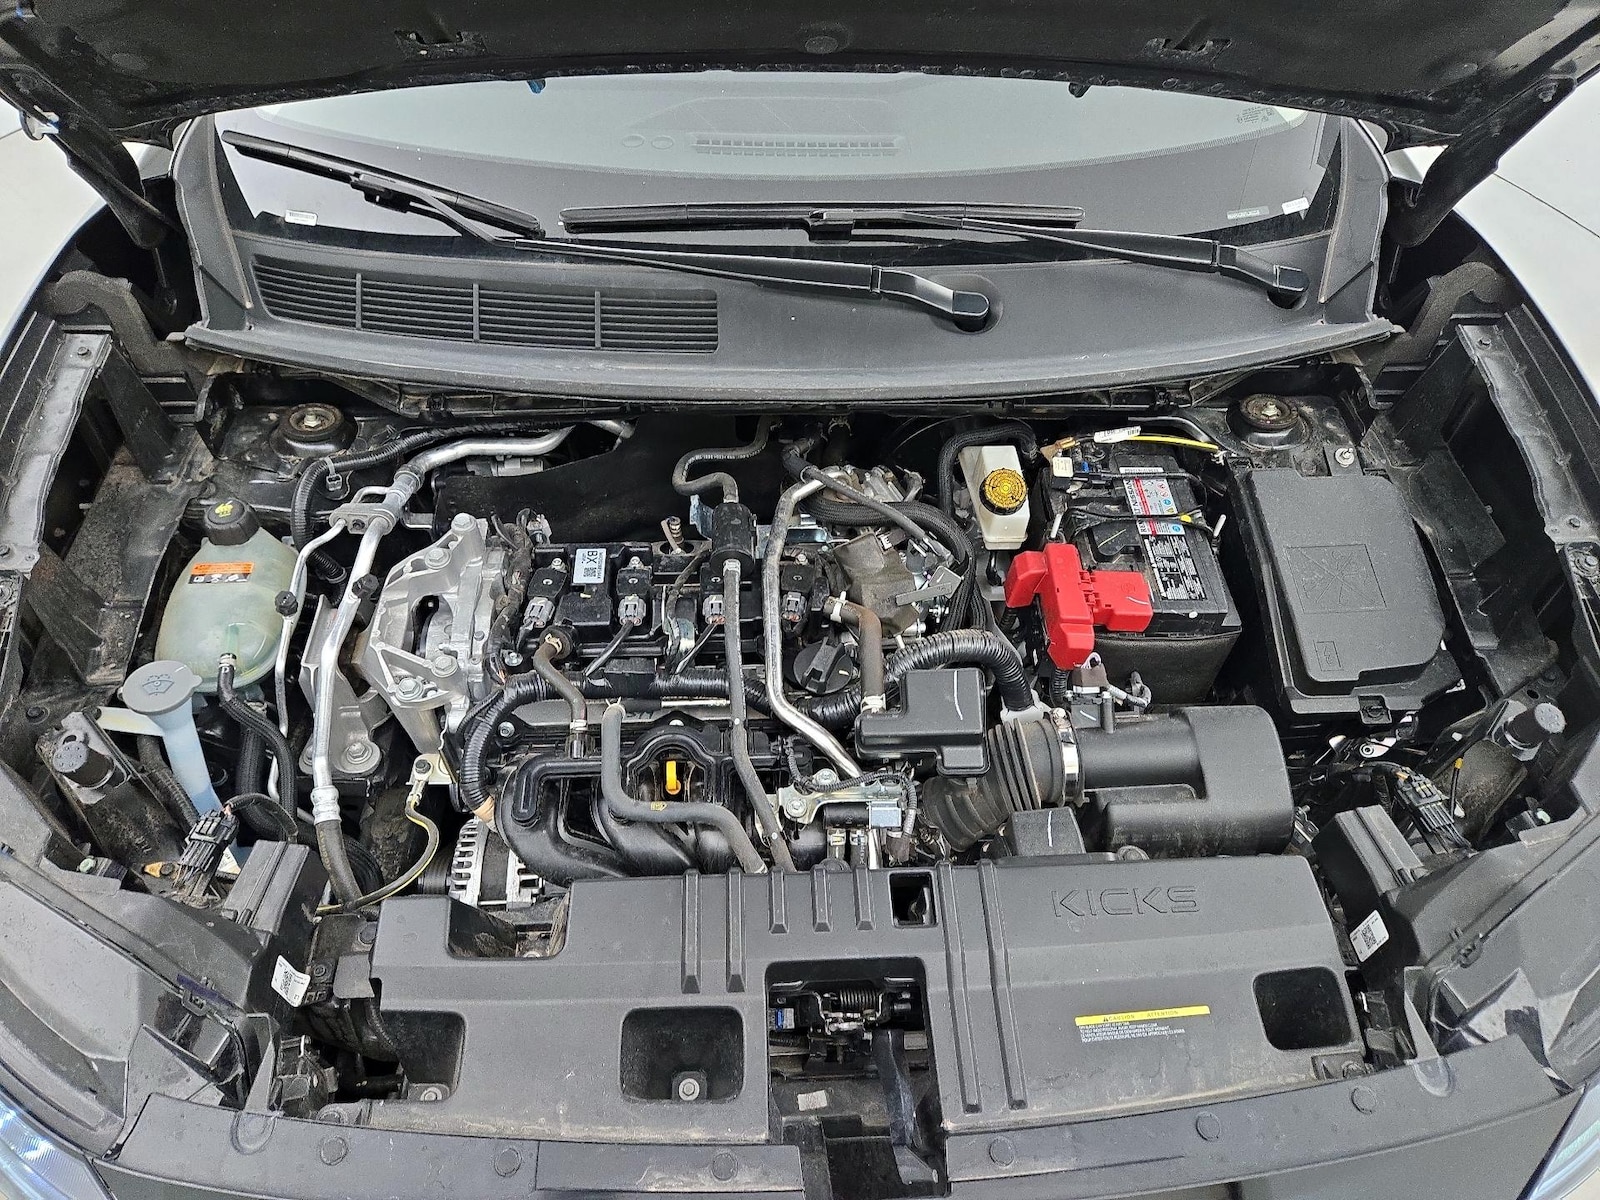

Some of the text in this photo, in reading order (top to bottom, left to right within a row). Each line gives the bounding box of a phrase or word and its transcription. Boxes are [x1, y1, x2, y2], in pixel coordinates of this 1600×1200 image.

[1125, 480, 1139, 508] NISSAN
[587, 550, 598, 564] BX
[1051, 886, 1201, 917] KICKS
[1146, 1010, 1179, 1018] ATTENTION
